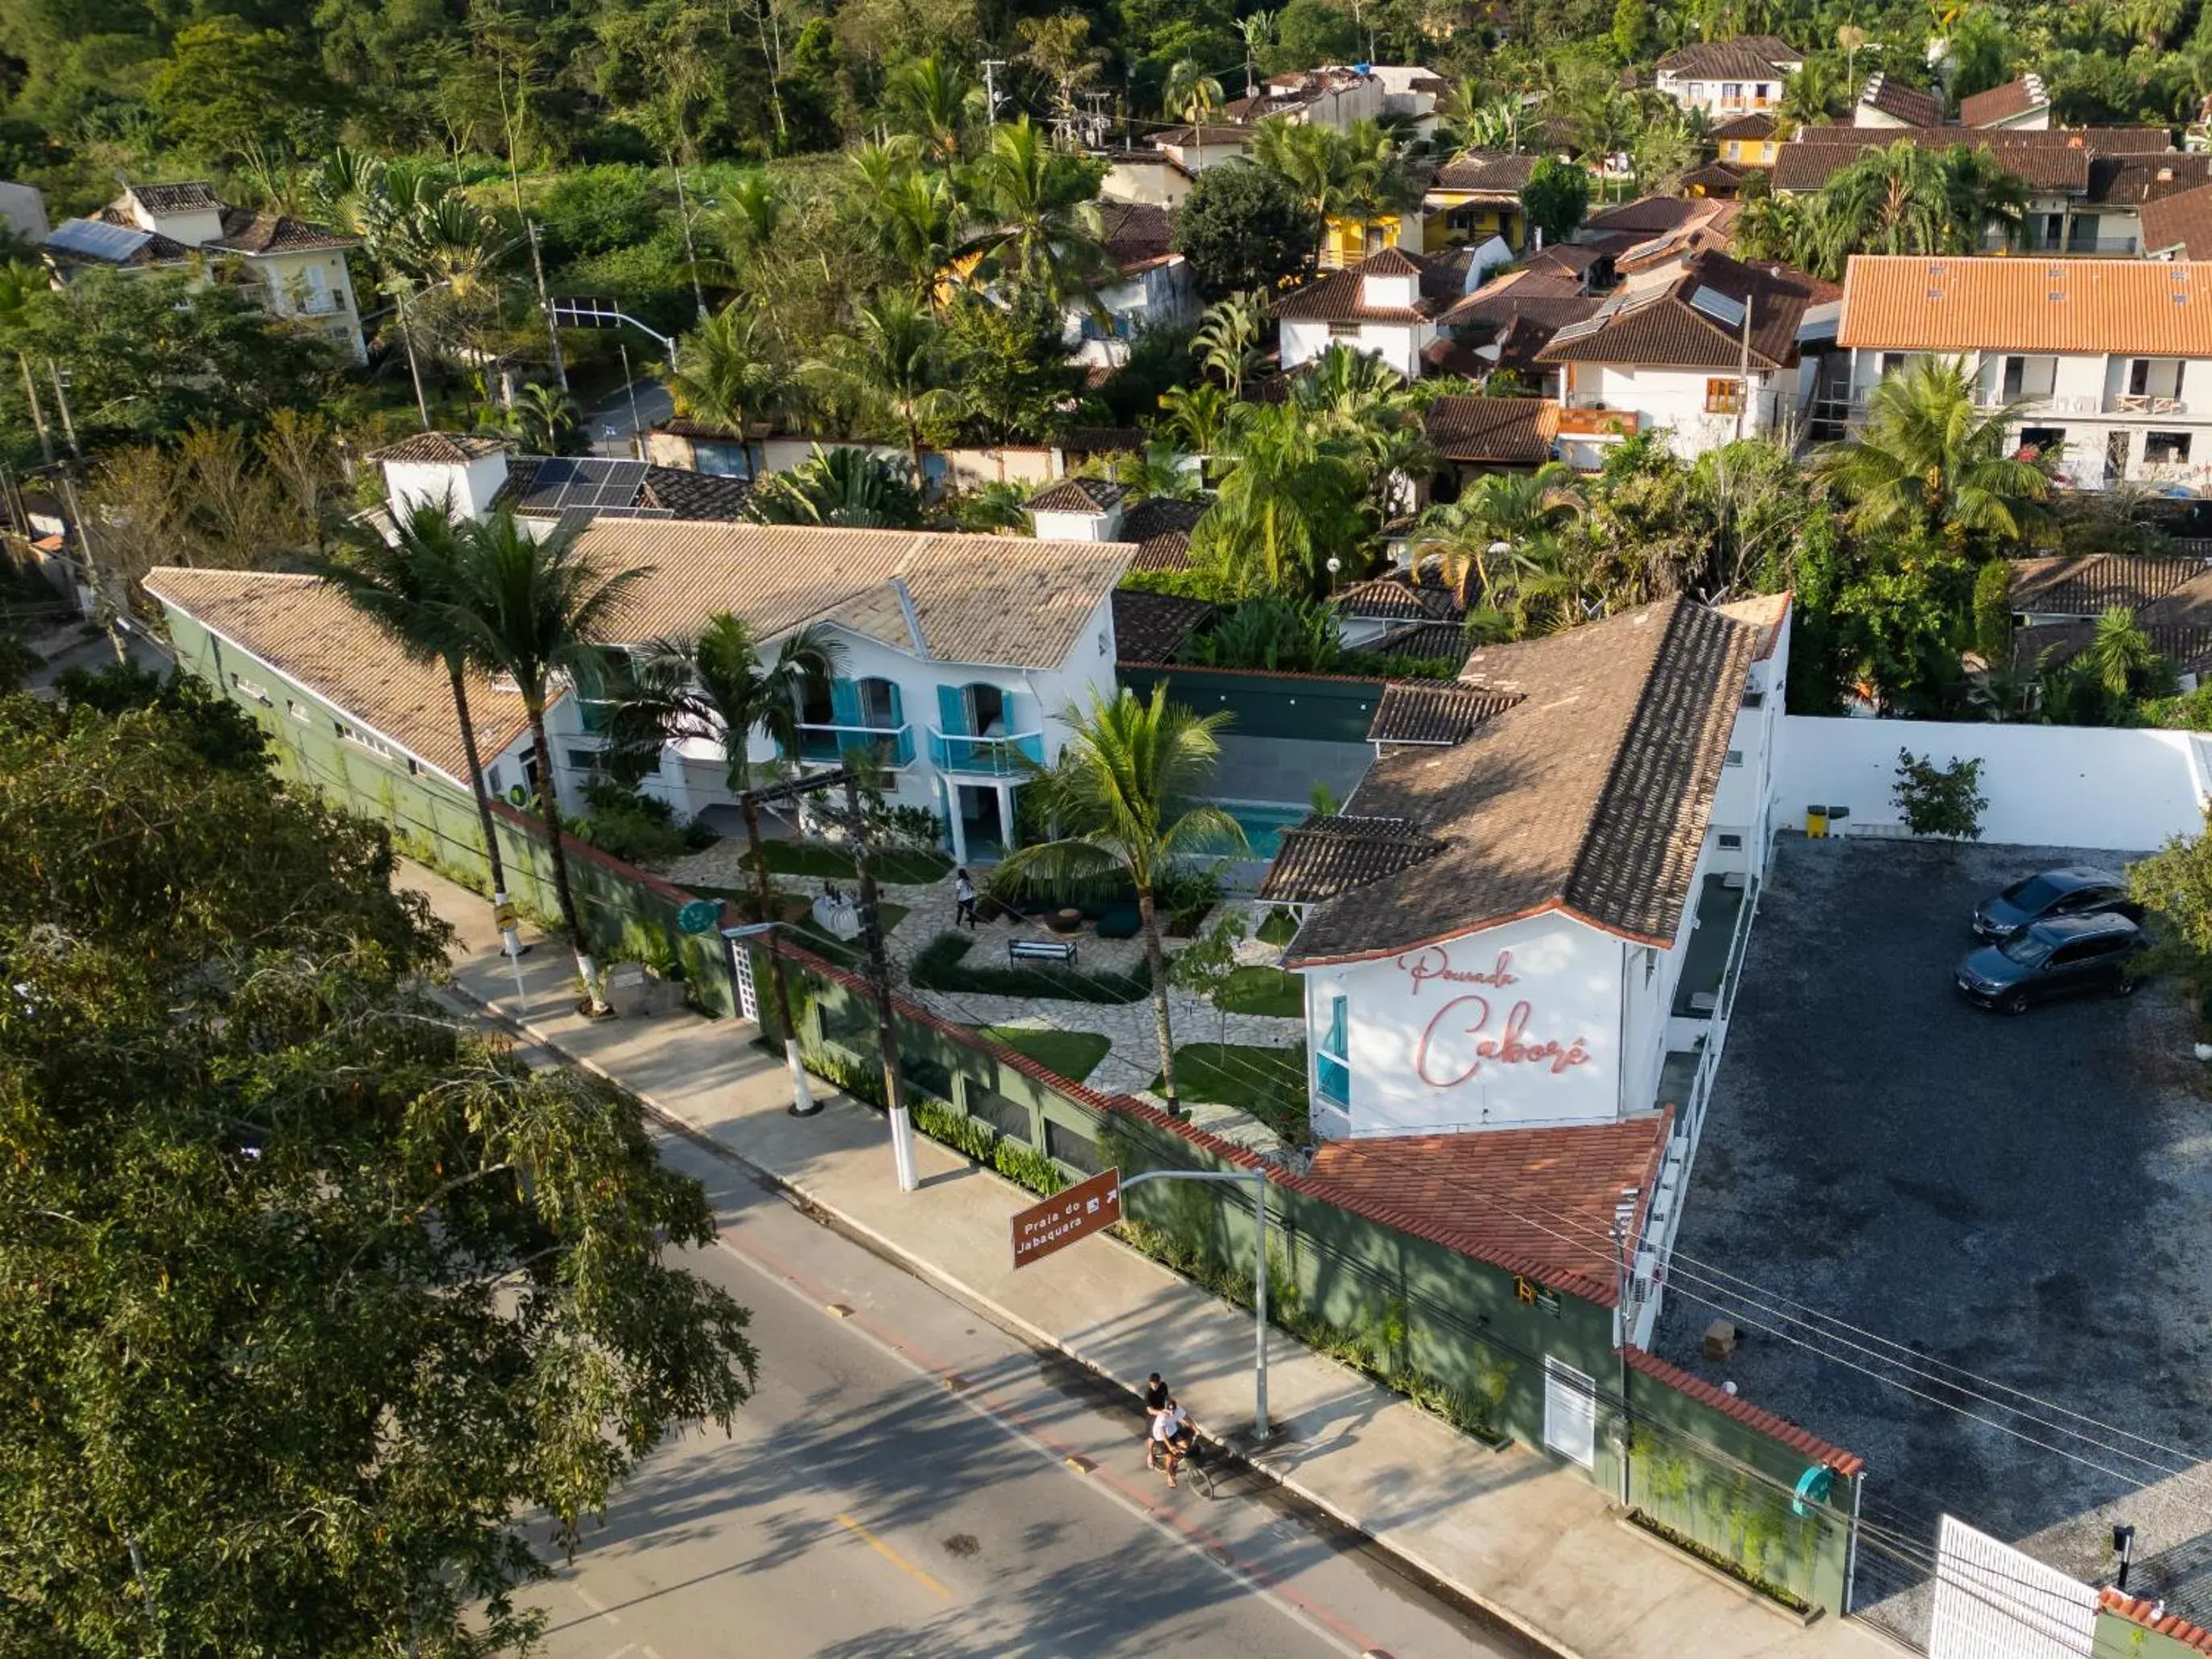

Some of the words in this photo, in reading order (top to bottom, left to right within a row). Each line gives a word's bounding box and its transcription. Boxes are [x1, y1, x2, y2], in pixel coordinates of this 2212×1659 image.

[1398, 945, 1519, 995] Pousada
[1415, 994, 1591, 1087] Caboré
[1017, 1217, 1081, 1254] Jabaquara
[1024, 1212, 1060, 1235] Praia
[1065, 1203, 1080, 1215] do
